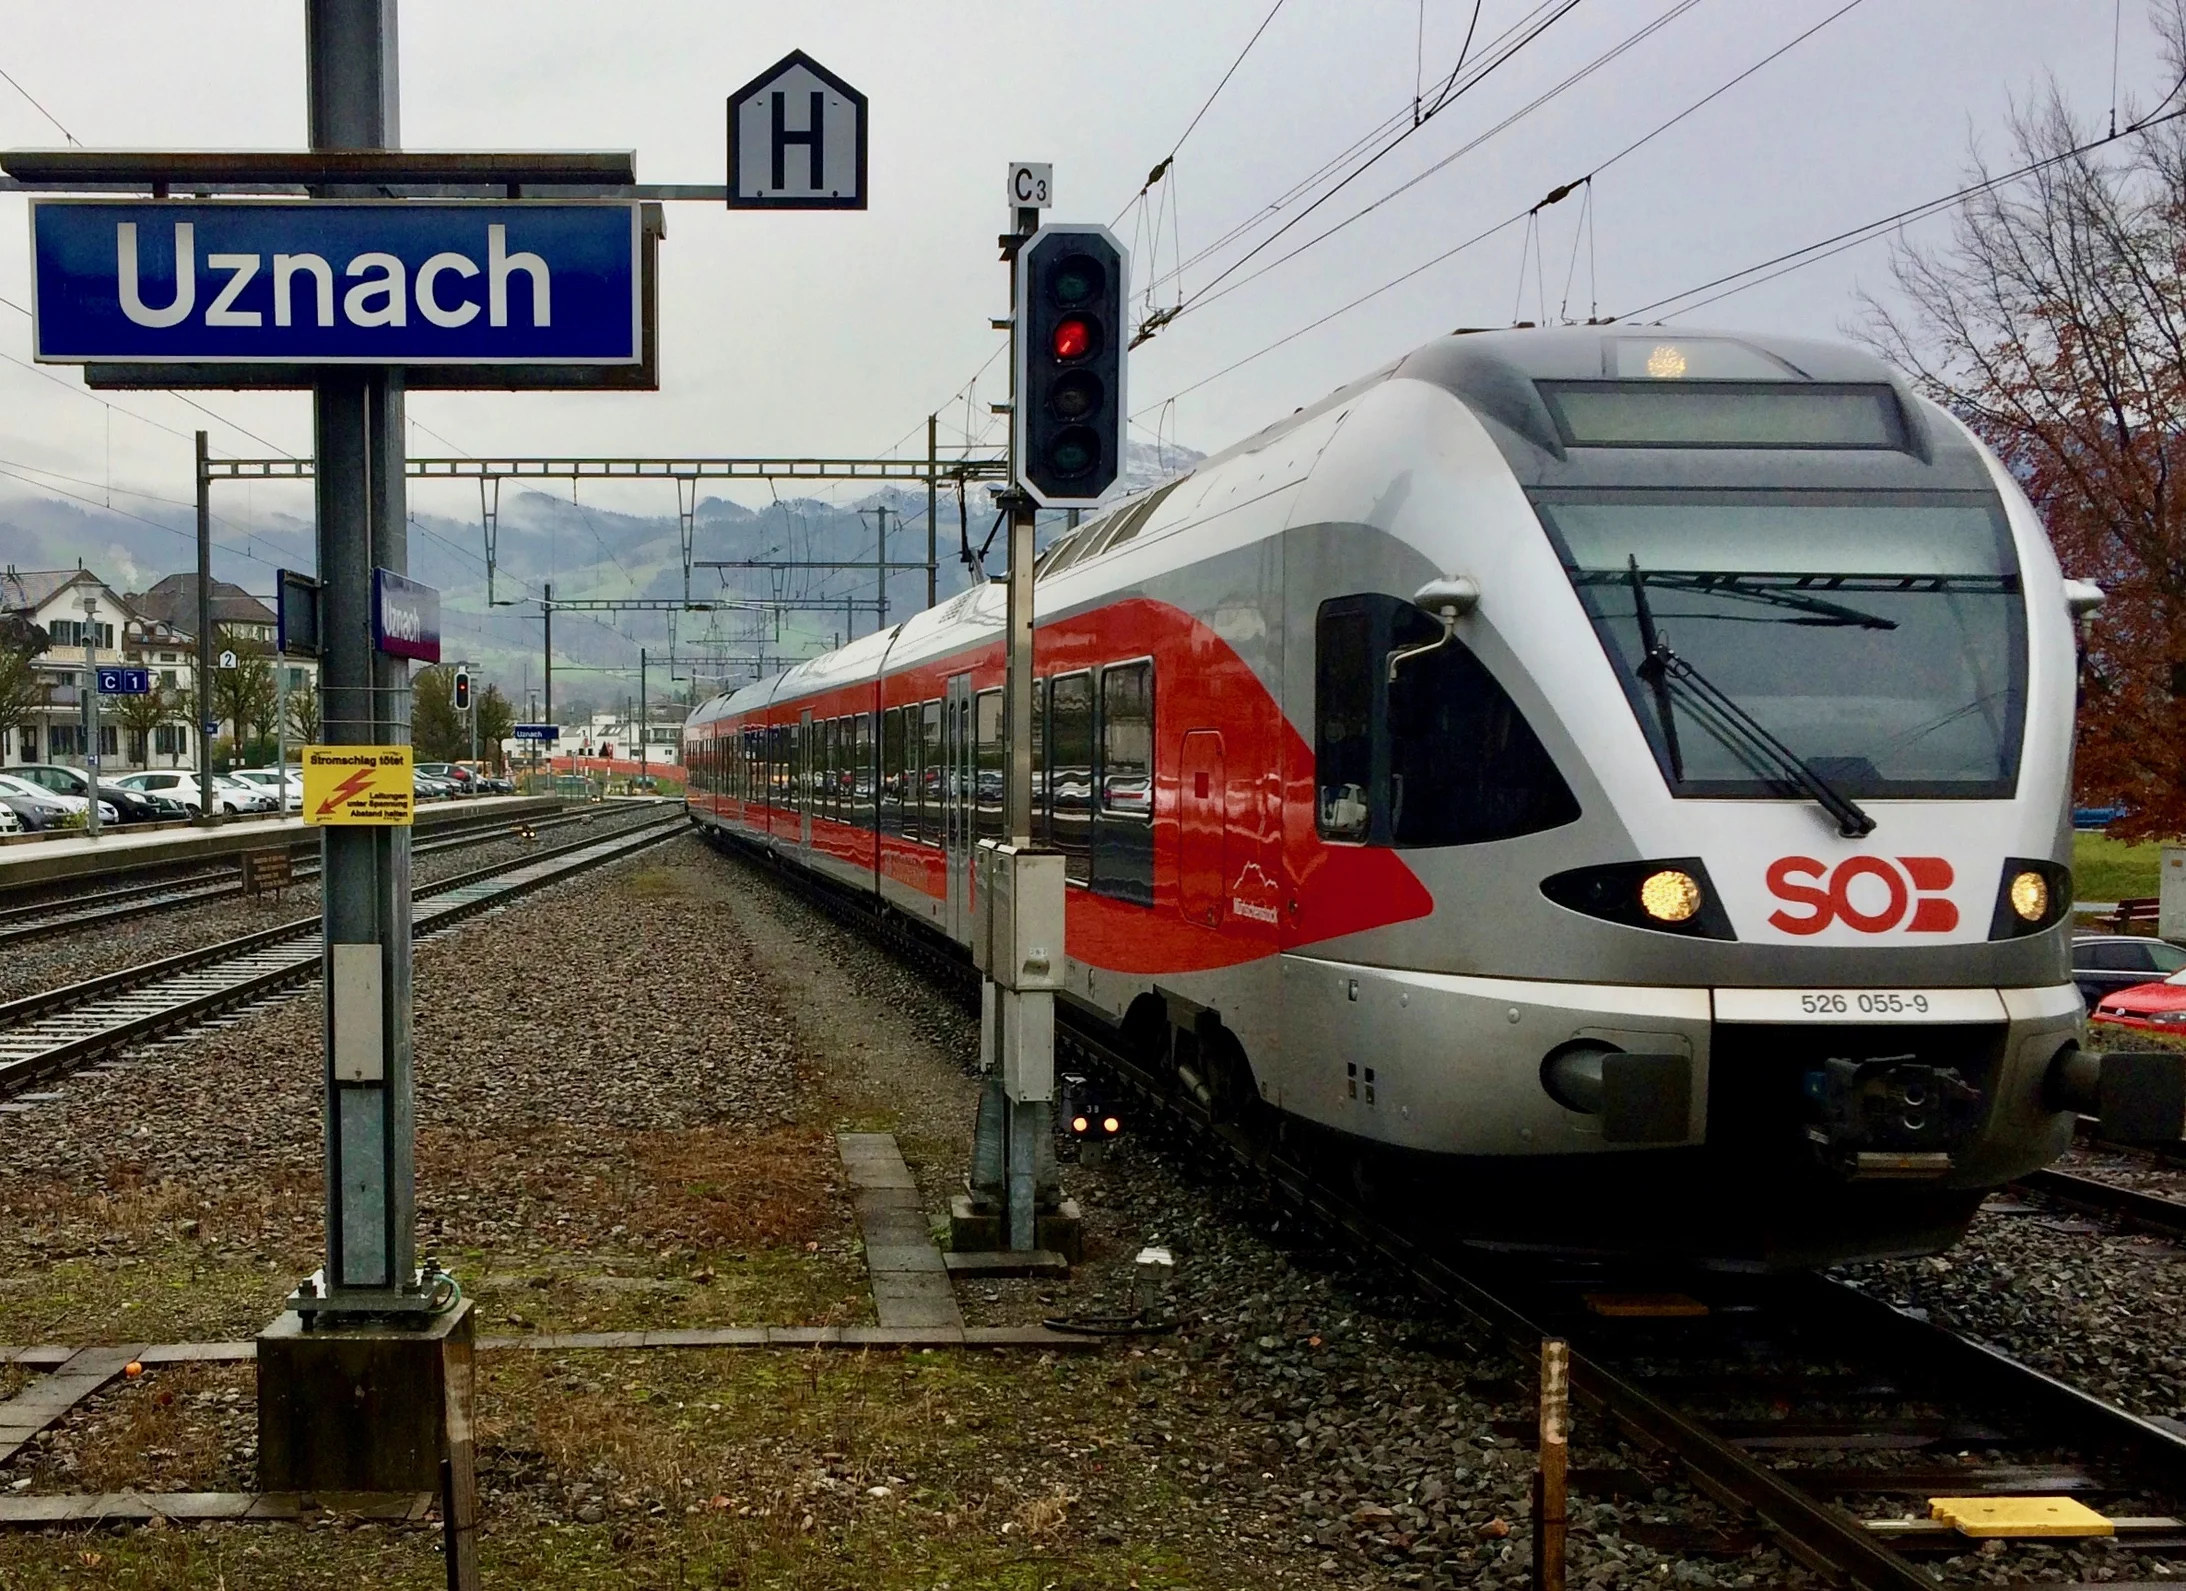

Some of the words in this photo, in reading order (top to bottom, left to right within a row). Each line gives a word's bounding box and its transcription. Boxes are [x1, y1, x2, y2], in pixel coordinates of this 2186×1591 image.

[771, 91, 824, 190] H
[116, 221, 551, 328] Uznach
[383, 598, 420, 644] Uznach
[224, 653, 232, 667] 2
[104, 676, 117, 690] C
[131, 676, 138, 690] 1
[516, 730, 543, 738] Uznach
[310, 755, 377, 768] Stromschlag
[379, 755, 404, 766] tötet
[369, 791, 408, 801] Leitungen
[347, 800, 367, 808] unter
[369, 800, 408, 809] Spannung
[350, 809, 382, 817] Abstand
[384, 809, 408, 817] halten
[1766, 855, 1960, 936] SOB
[1801, 994, 1848, 1014] 526
[1857, 994, 1929, 1014] 055-9
